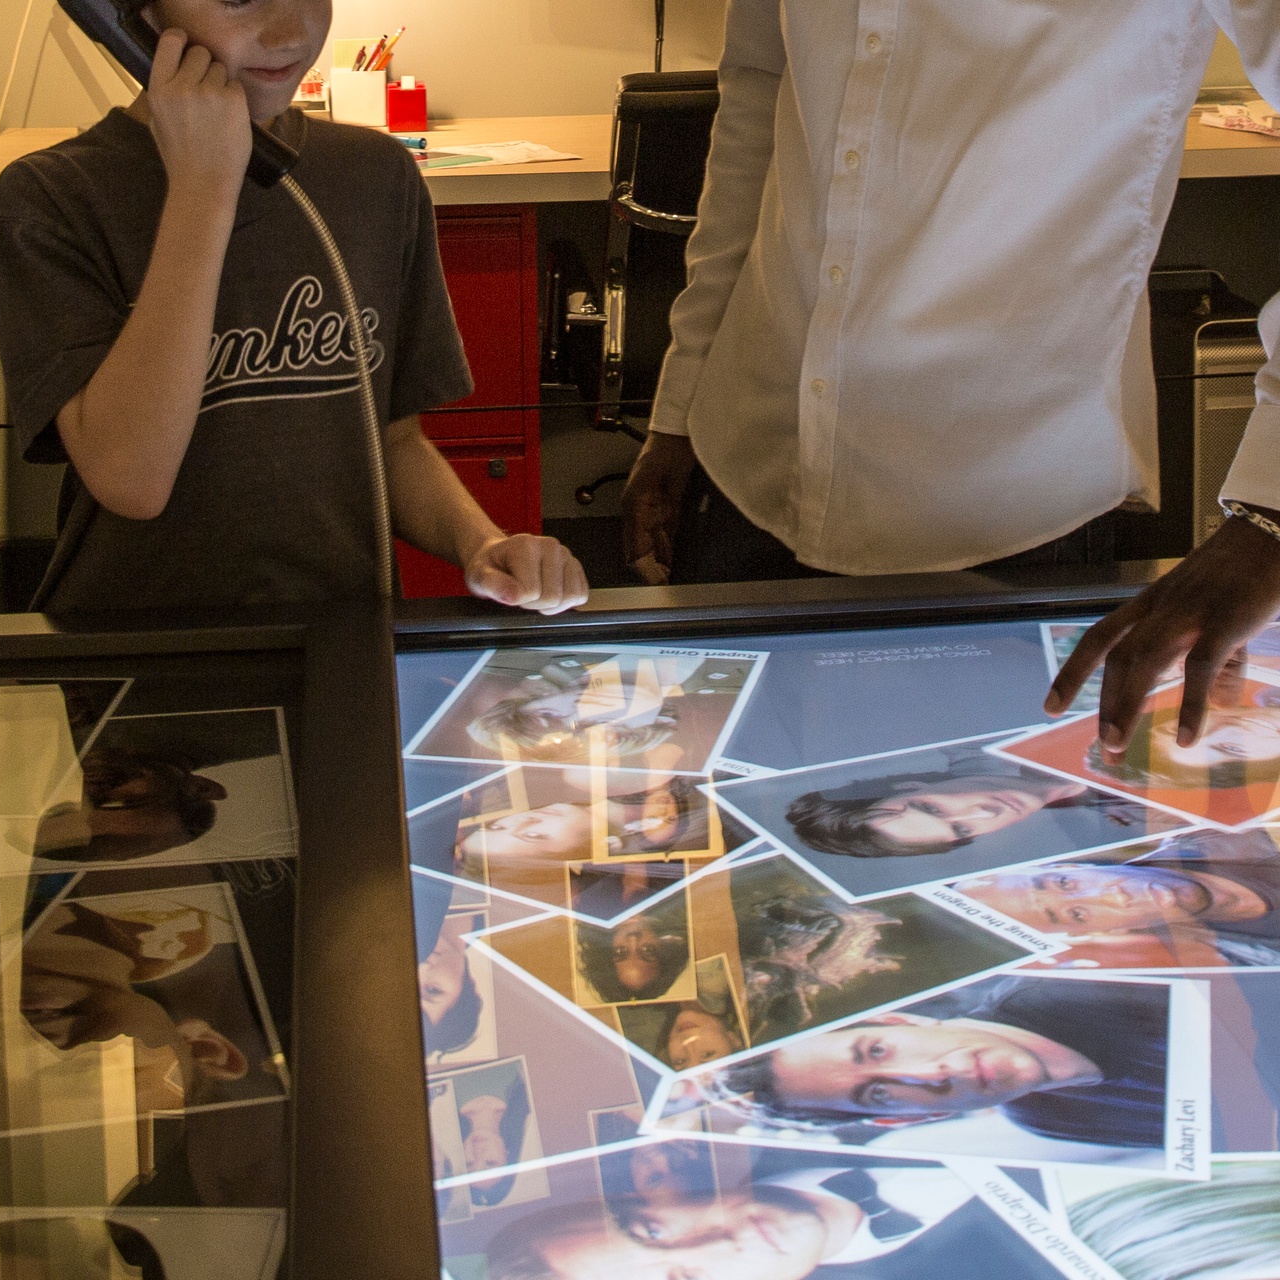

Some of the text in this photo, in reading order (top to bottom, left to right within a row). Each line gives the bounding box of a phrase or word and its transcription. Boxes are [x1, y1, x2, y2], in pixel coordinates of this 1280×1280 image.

[659, 649, 759, 660] Rupert Grint
[812, 648, 992, 667] DRAG HEADSHOT HERE
[856, 647, 911, 657] DEMO
[932, 890, 1055, 951] Smaug the Dragon
[1174, 1098, 1202, 1172] Zachary Levi
[982, 1180, 1108, 1280] onardo DiCaprio
